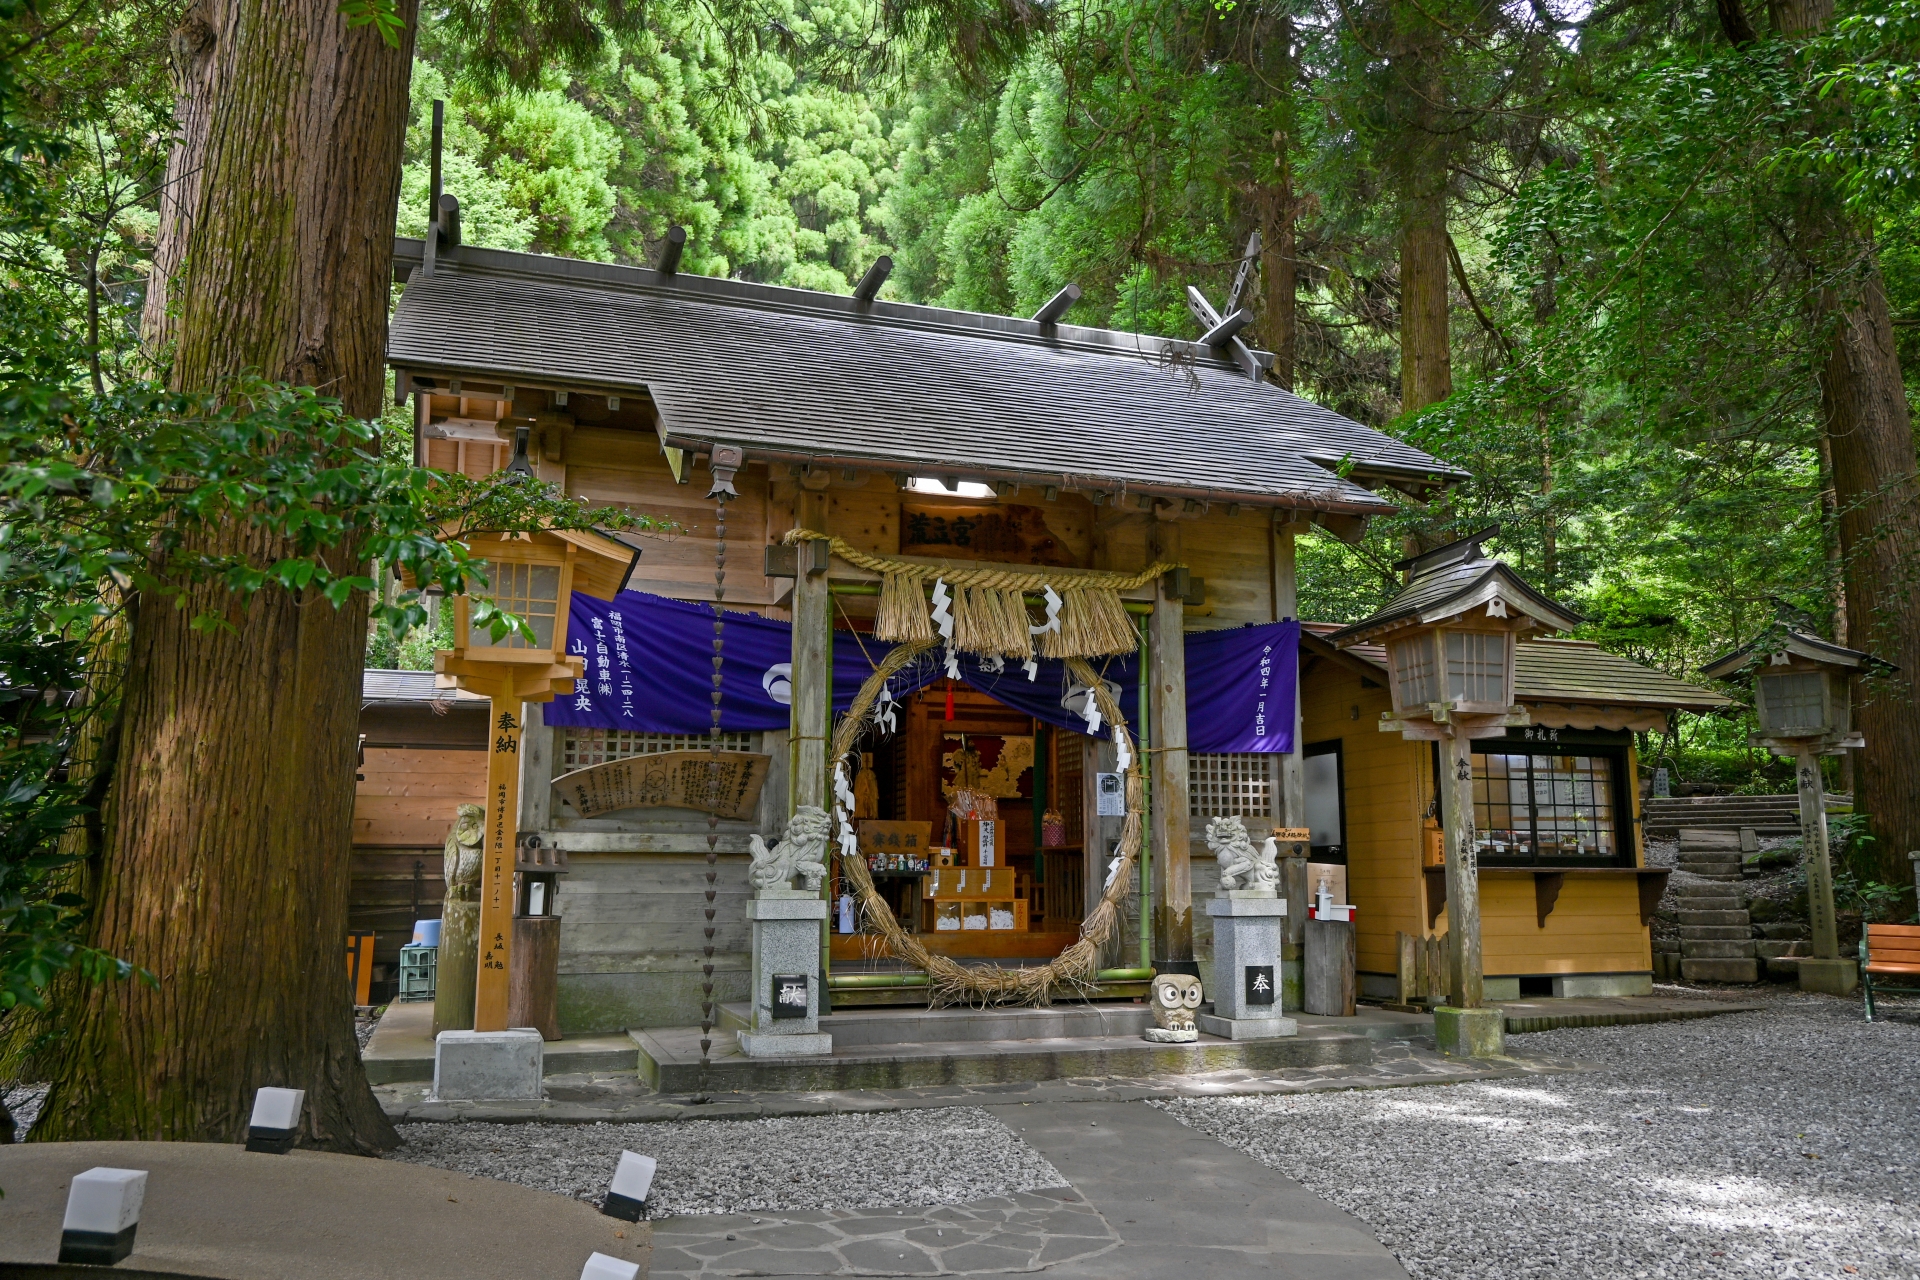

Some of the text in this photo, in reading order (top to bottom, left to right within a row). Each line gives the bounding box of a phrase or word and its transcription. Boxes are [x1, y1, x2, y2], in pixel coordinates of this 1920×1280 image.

[1255, 645, 1272, 736] 令和四年一月吉日
[495, 711, 518, 754] 奉納
[1524, 728, 1559, 742] 御札所
[779, 984, 802, 1004] 献
[1252, 972, 1271, 994] 奉
